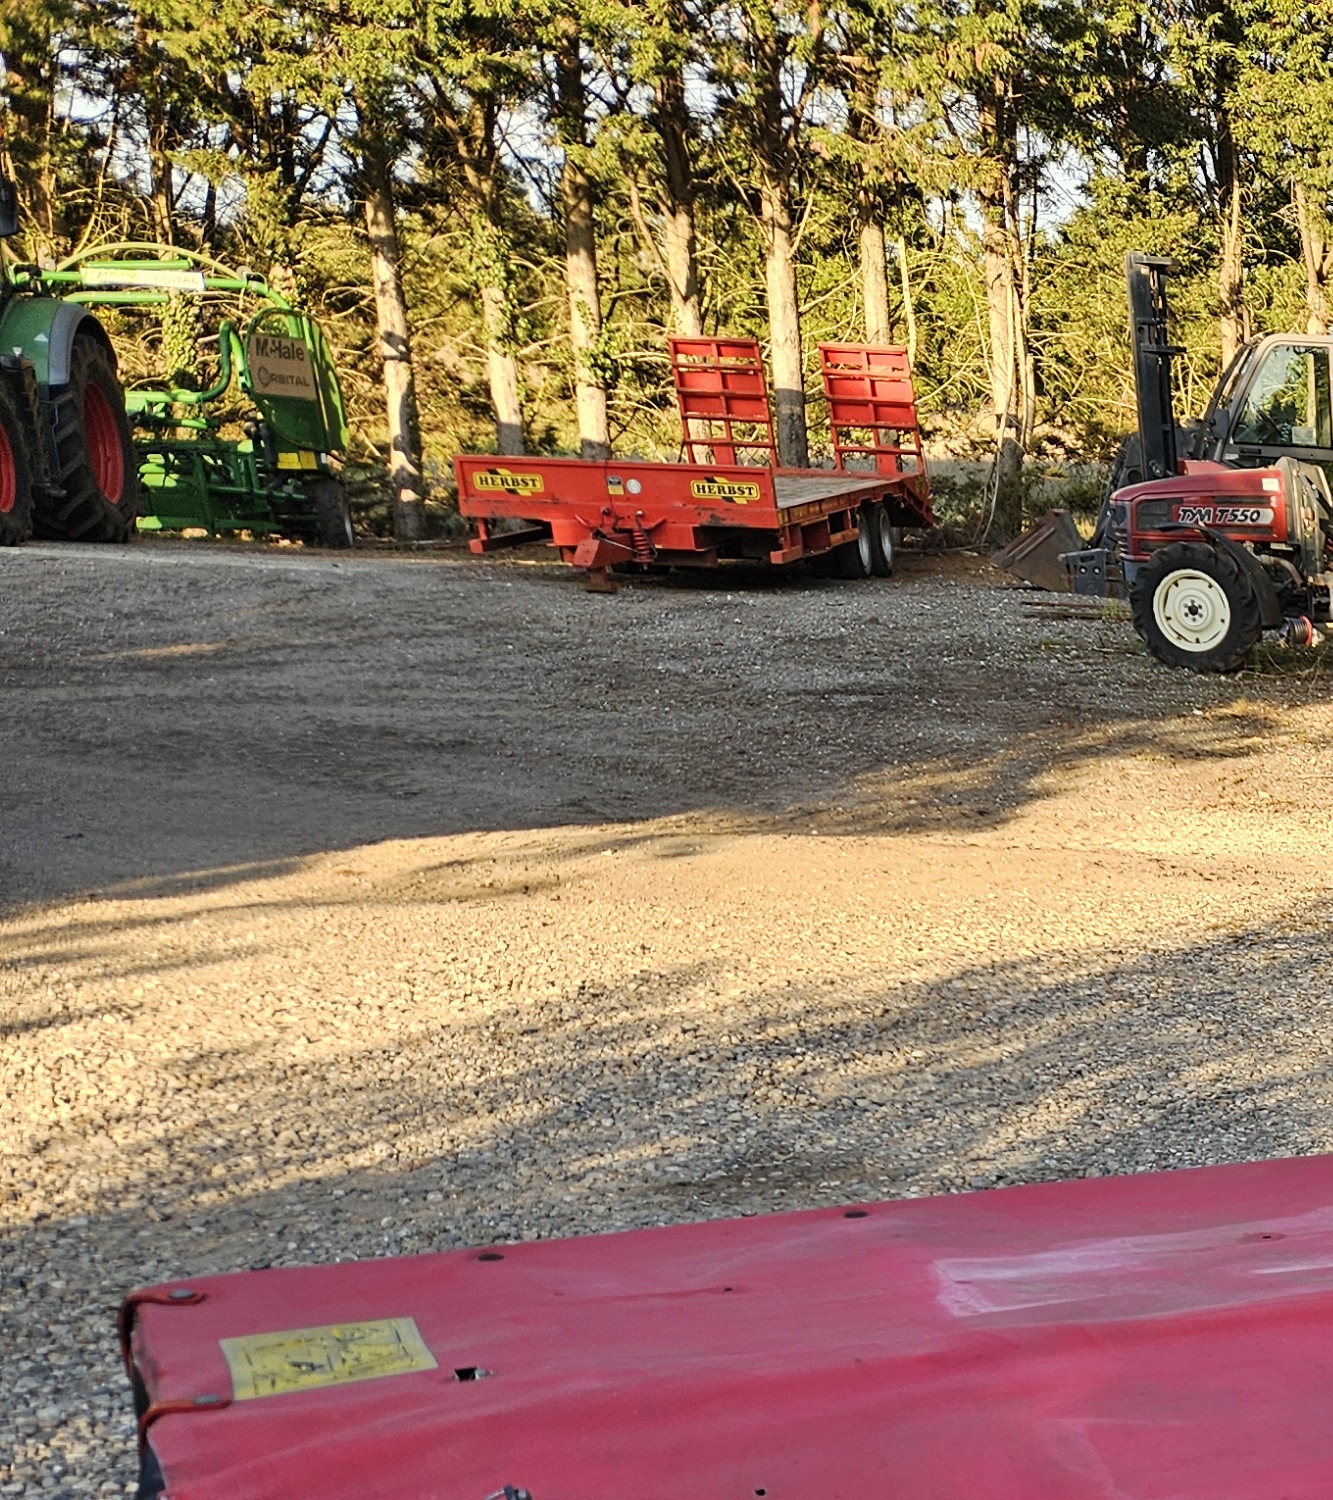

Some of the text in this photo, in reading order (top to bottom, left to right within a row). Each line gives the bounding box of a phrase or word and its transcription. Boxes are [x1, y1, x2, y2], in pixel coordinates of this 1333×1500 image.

[256, 337, 304, 361] McHale
[257, 366, 310, 388] ORBITAL
[479, 475, 538, 487] HERBST
[696, 484, 754, 496] HERBST
[1180, 507, 1260, 523] TYM T550
